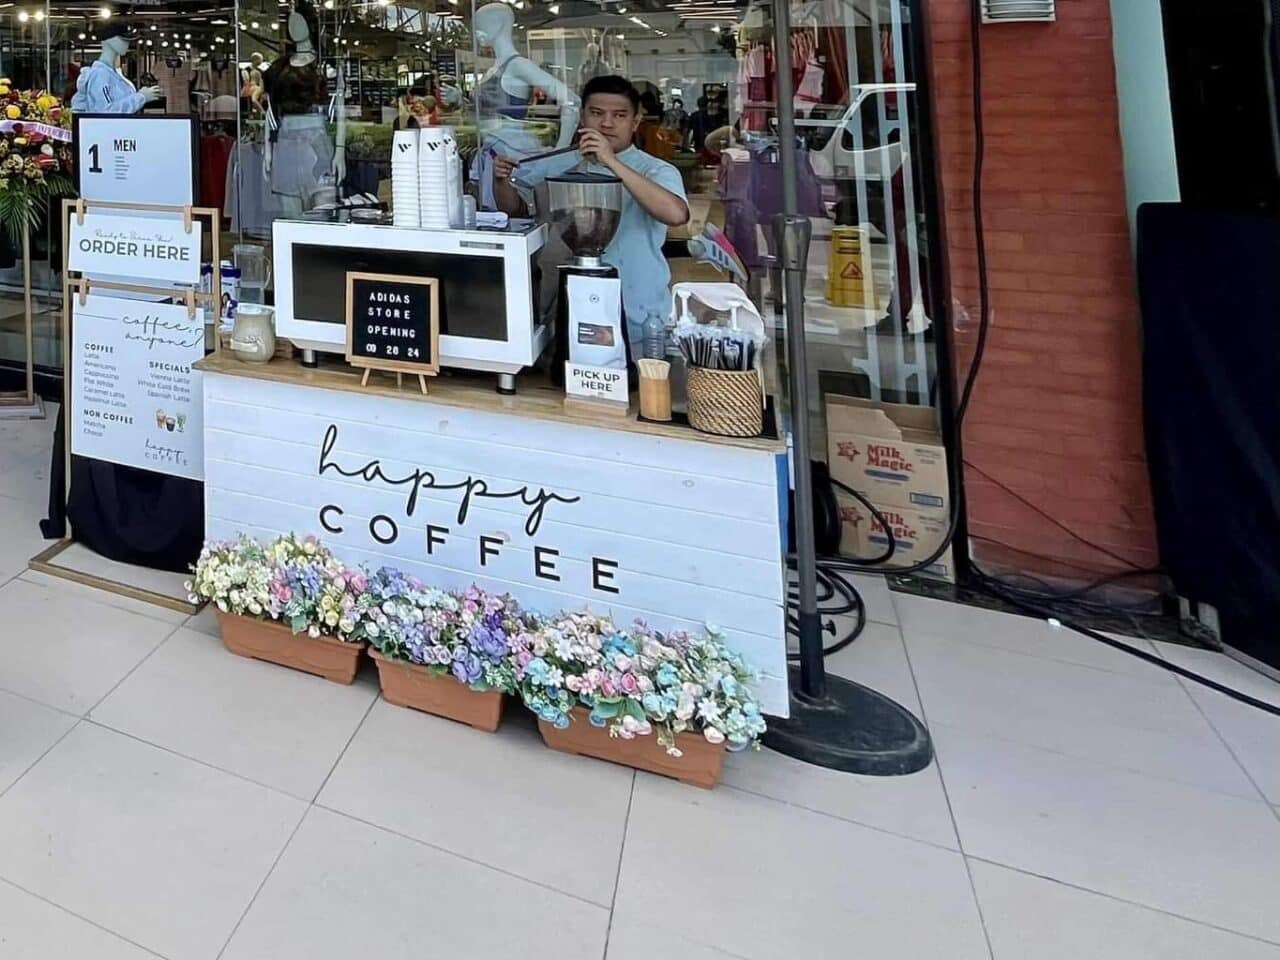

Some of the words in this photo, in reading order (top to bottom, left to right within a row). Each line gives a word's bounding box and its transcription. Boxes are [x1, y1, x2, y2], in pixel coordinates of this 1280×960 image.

[113, 139, 137, 152] MEN
[88, 143, 103, 173] 1
[79, 238, 138, 257] ORDER
[143, 244, 190, 261] HERE
[369, 291, 410, 304] ADIDAS
[367, 306, 411, 320] STORE
[367, 325, 416, 338] OPENING
[84, 343, 114, 354] COFFEE
[407, 347, 419, 358] 24
[149, 361, 190, 374] SPECIALS
[573, 369, 600, 380] PICK
[603, 373, 620, 382] UP
[581, 380, 613, 392] HERE
[83, 409, 101, 418] NON
[103, 412, 134, 425] COFFEE
[867, 444, 905, 461] Milk
[867, 456, 916, 472] Magic
[319, 424, 581, 536] happy
[870, 520, 919, 539] Mgic
[319, 504, 620, 594] COFFEE
